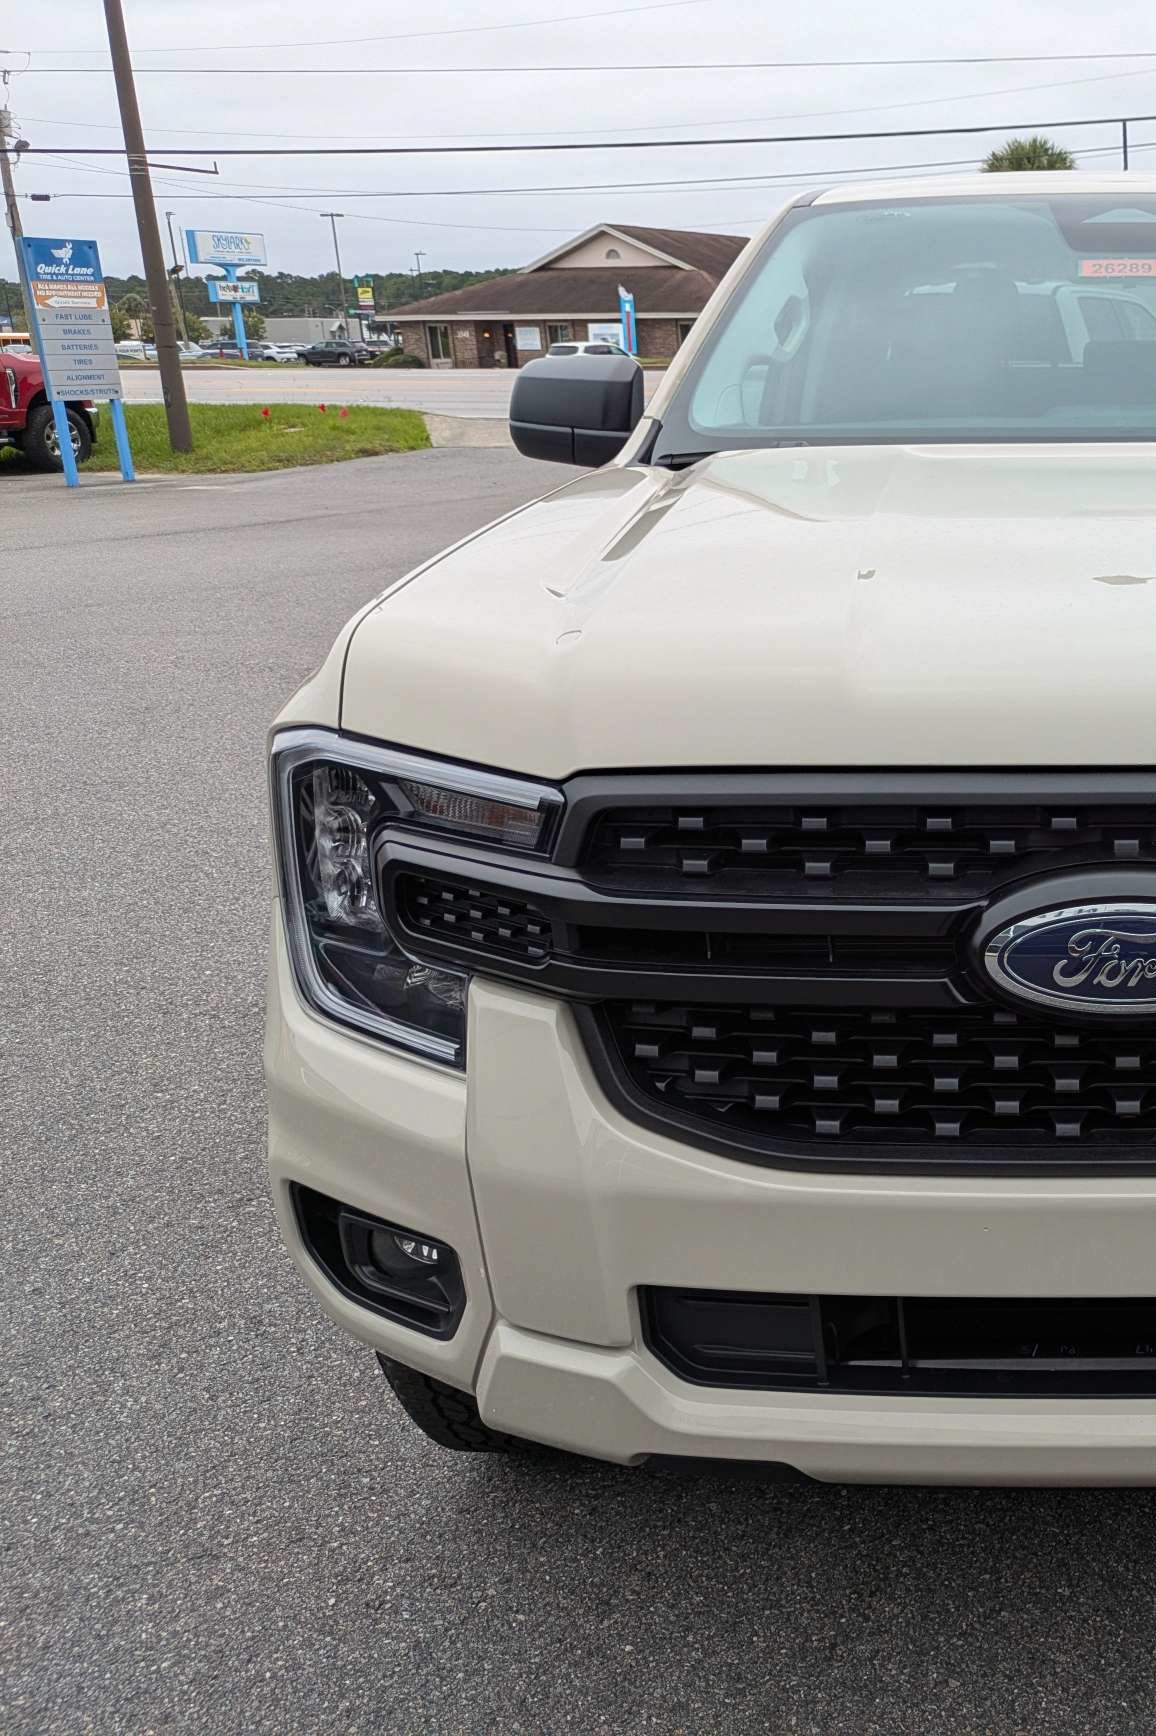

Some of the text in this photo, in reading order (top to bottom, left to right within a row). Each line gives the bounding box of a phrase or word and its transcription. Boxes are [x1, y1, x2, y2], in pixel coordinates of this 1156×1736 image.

[36, 264, 95, 275] Quick Lane
[1091, 263, 1153, 274] 26289
[62, 328, 92, 336] BRAKES
